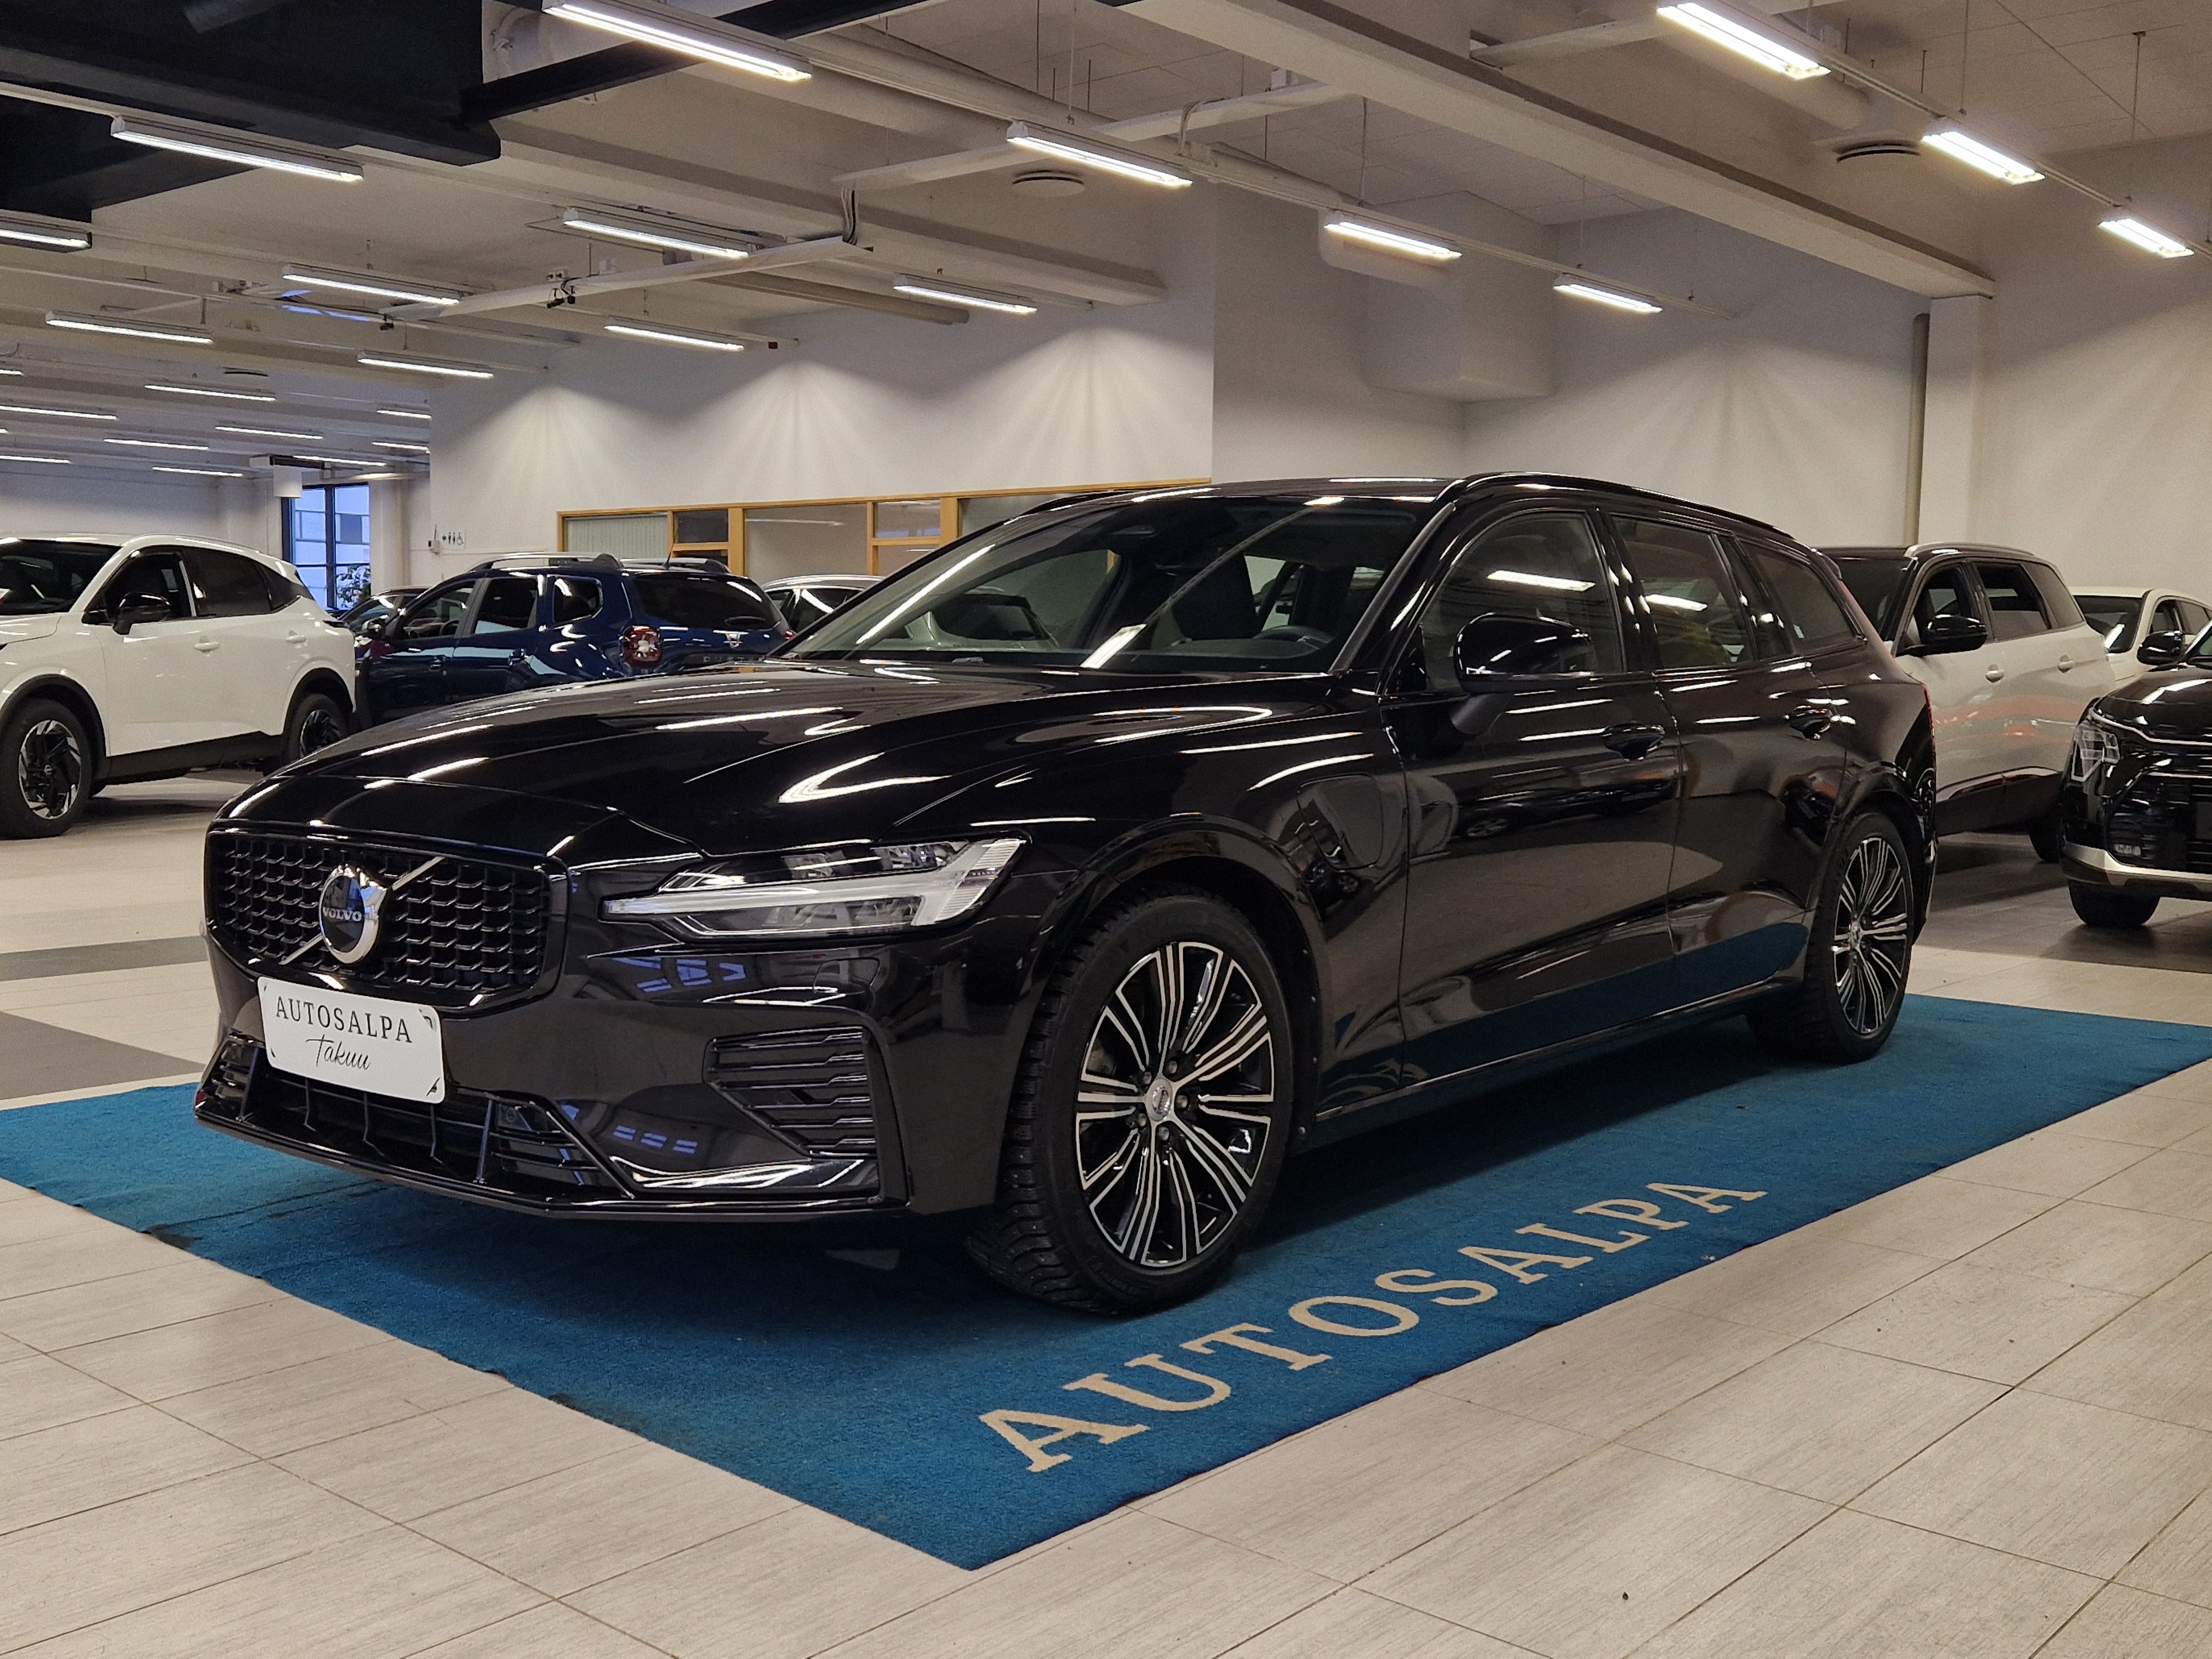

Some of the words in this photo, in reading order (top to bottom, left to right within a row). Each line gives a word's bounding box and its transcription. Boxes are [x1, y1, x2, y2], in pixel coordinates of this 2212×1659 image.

[322, 906, 362, 922] VOLVO
[276, 996, 413, 1043] AUTOSALPA
[306, 1034, 371, 1070] Takuu
[979, 1182, 1768, 1472] AUTOSALPA
